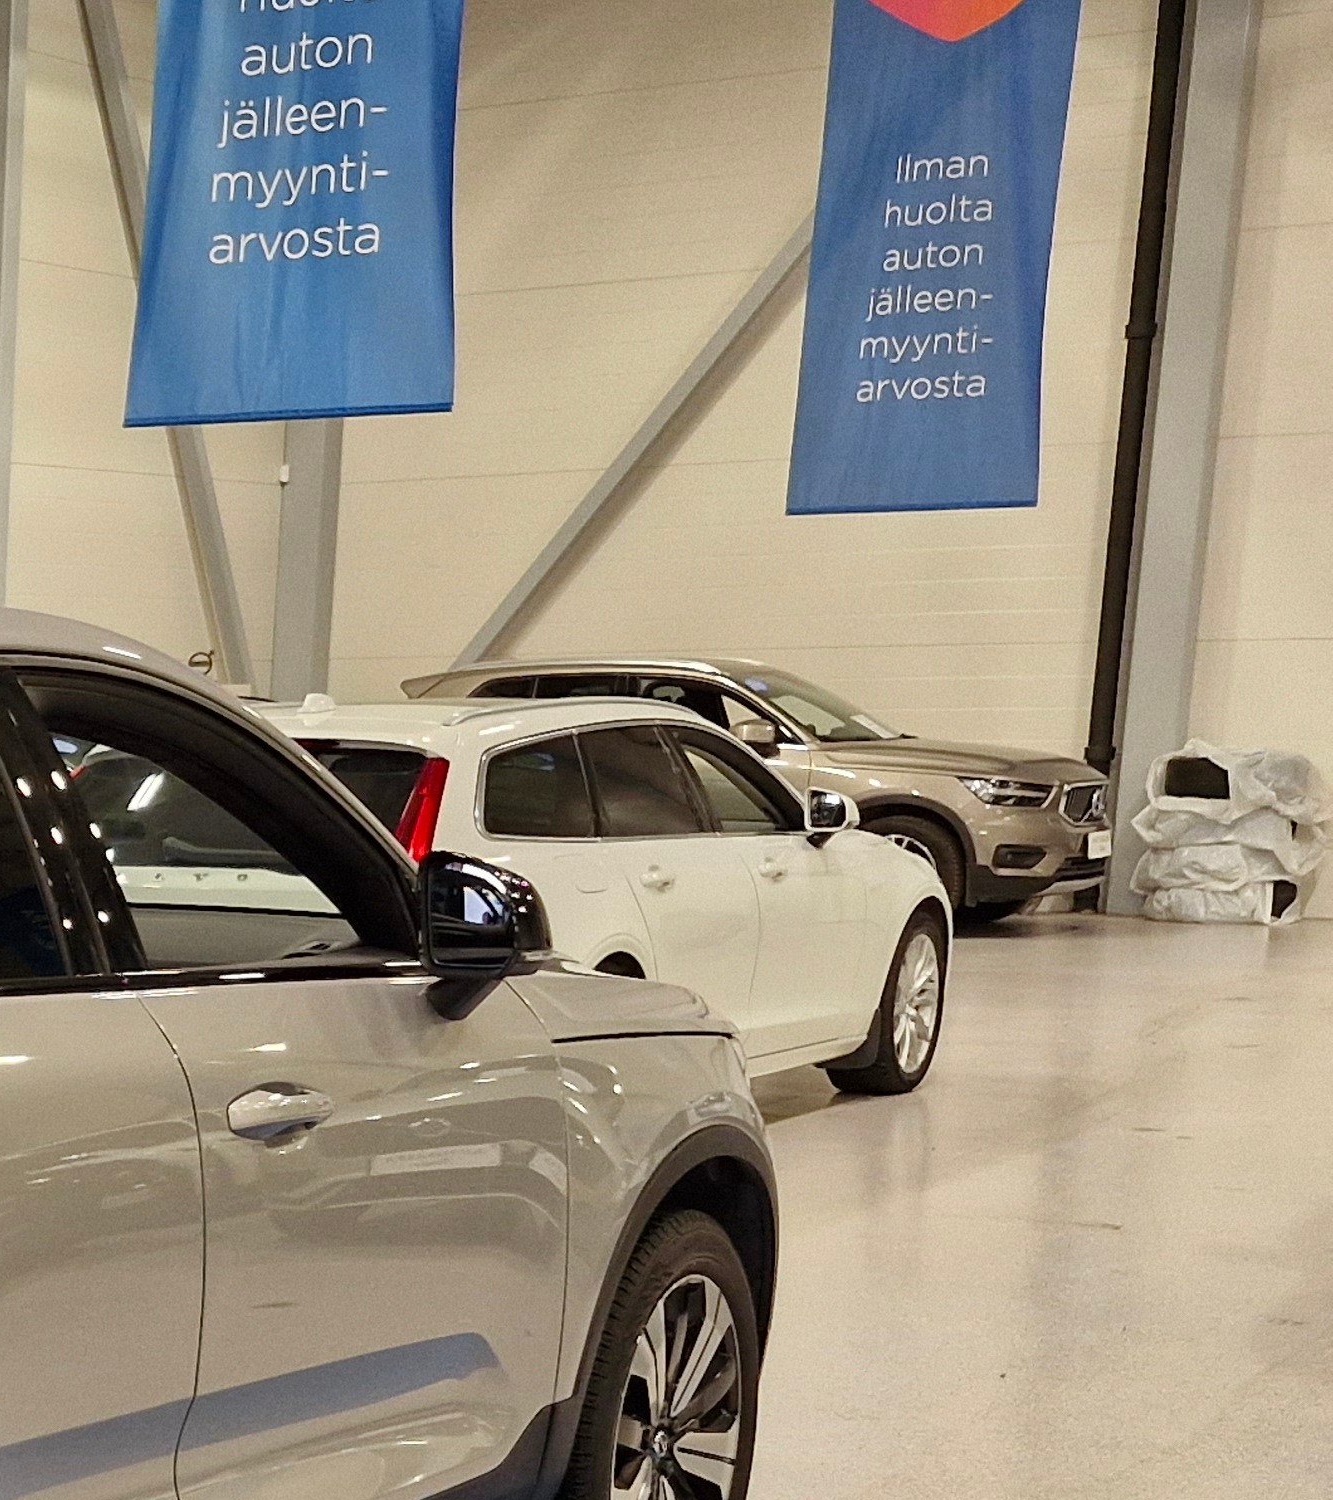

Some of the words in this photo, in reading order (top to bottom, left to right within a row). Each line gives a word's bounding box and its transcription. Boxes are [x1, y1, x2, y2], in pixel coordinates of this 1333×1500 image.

[240, 32, 373, 76] auton
[217, 95, 388, 148] jälleen-
[210, 151, 390, 208] myynti-
[895, 153, 989, 184] Ilman
[884, 193, 993, 228] huolta
[208, 217, 381, 264] arvosta
[882, 241, 983, 272] auton
[865, 285, 993, 322] jälleen-
[858, 325, 994, 363] myynti-
[856, 370, 986, 402] arvosta
